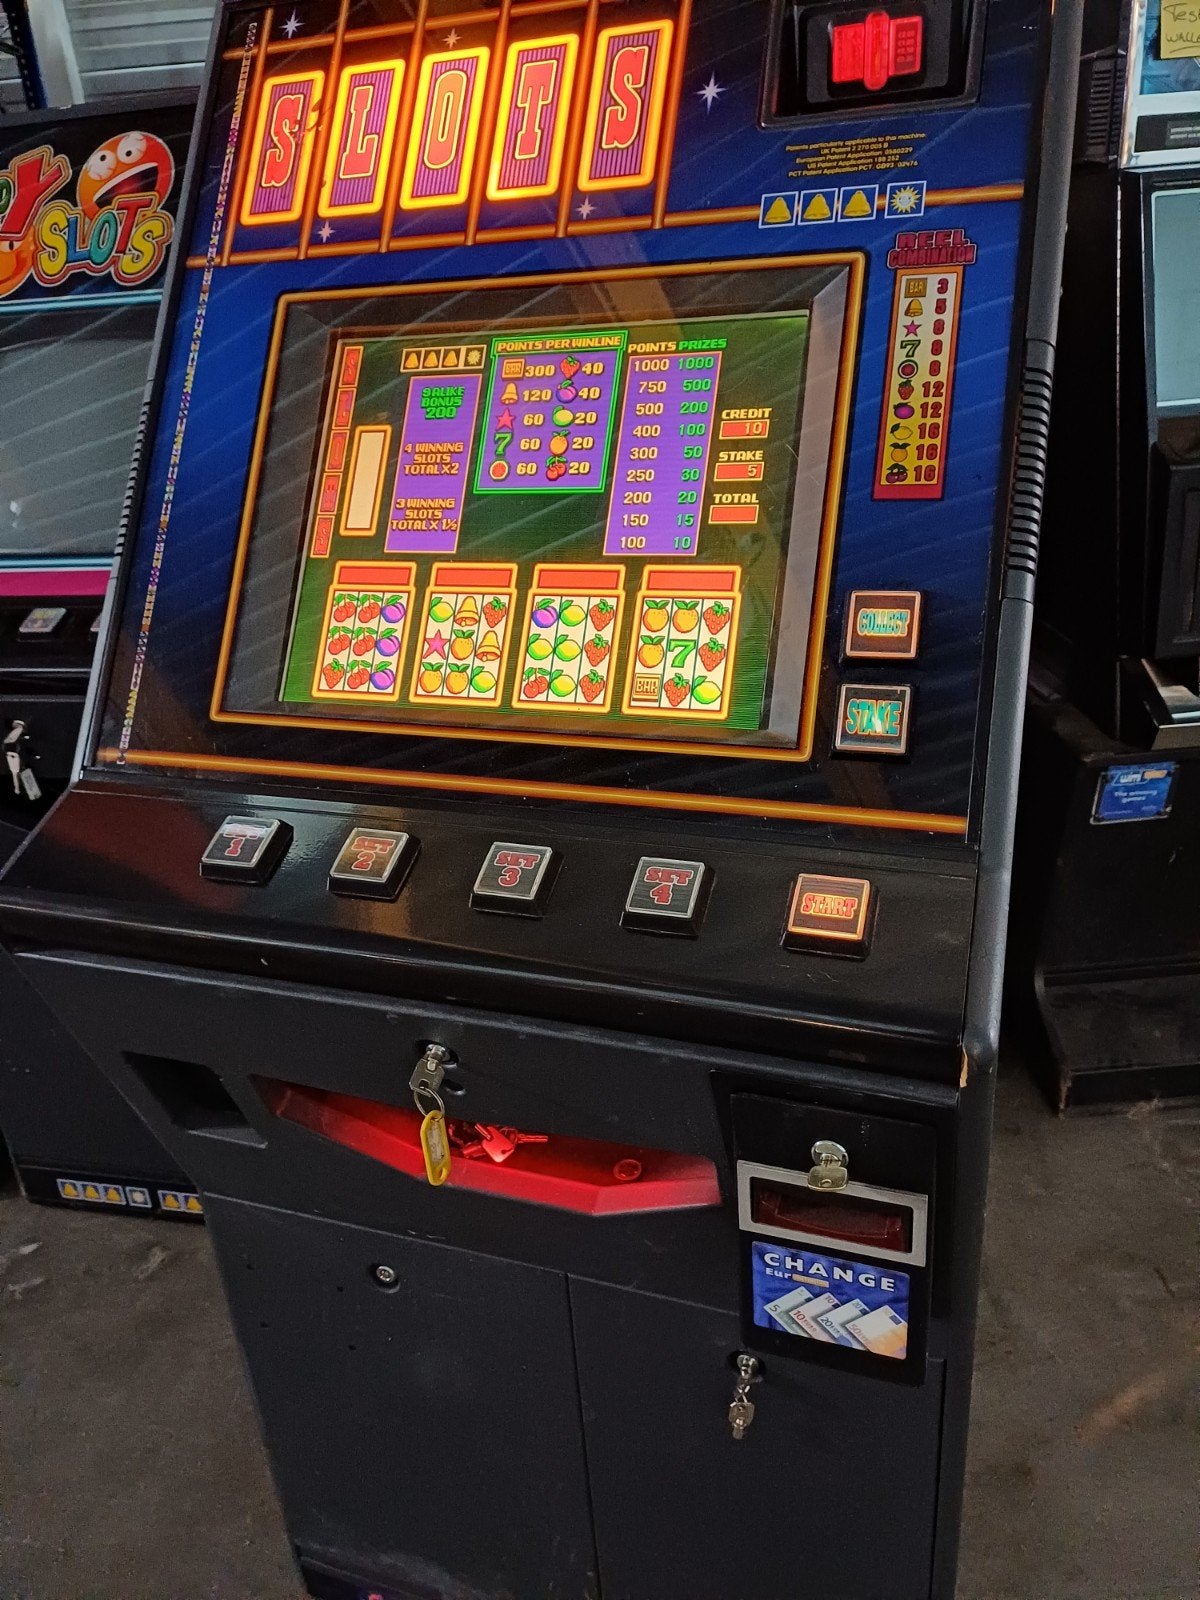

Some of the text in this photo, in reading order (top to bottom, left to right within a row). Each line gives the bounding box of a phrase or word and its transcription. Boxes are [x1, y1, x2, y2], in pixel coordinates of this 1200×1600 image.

[261, 45, 650, 188] SLOTS
[809, 140, 844, 150] particularly
[844, 136, 877, 146] applicable
[795, 155, 826, 164] European
[826, 153, 847, 161] Patent
[817, 160, 837, 168] Patent
[838, 158, 873, 167] Application
[802, 168, 823, 176] Patent
[823, 165, 858, 175] Application
[36, 196, 169, 279] SLOTS
[896, 229, 970, 249] REEL
[888, 245, 976, 268] COMBINATION
[936, 277, 949, 295] 3
[934, 297, 947, 315] 5
[932, 318, 945, 335] 8
[497, 336, 622, 352] POINTS PER WINLINE
[627, 338, 728, 353] POINTS PRIZES
[900, 339, 943, 358] 7 8
[524, 364, 556, 378] 300
[581, 362, 604, 375] 40
[633, 356, 715, 372] 1000 1000
[928, 360, 941, 377] 8
[431, 386, 465, 397] ALIKE
[638, 378, 712, 393] 750 500
[922, 380, 944, 398] 12
[421, 396, 463, 407] BONUS
[522, 386, 601, 402] 120 40
[425, 406, 457, 419] 200
[635, 400, 709, 416] 500 200
[721, 407, 772, 420] CREDIT
[920, 402, 942, 419] 12
[523, 411, 598, 426] 60 20
[632, 422, 706, 438] 400 100
[743, 422, 763, 435] 10
[917, 423, 940, 440] 16
[404, 442, 464, 453] 4 WINNING
[519, 438, 541, 450] 60
[571, 436, 594, 449] 20
[413, 453, 451, 464] SLOTS
[629, 445, 703, 460] 300 50
[718, 450, 764, 461] STAKE
[915, 443, 938, 460] 16
[404, 464, 440, 475] TOTAL
[516, 461, 591, 475] 60 20
[626, 468, 700, 482] 250 30
[747, 465, 757, 477] 5
[913, 465, 936, 482] 16
[395, 498, 456, 509] 3 WINNING
[623, 490, 697, 505] 200 20
[713, 493, 760, 504] TOTAL
[404, 509, 443, 519] SLOTS
[622, 513, 694, 527] 150 15
[390, 519, 428, 531] TOTAL
[620, 536, 692, 549] 100 10
[857, 608, 911, 638] COLLECT
[846, 698, 902, 737] STAKE
[225, 837, 245, 857] 1
[351, 835, 396, 854] SET
[351, 851, 376, 871] 2
[494, 850, 542, 868] SET
[498, 866, 522, 887] 3
[644, 866, 694, 885] SET
[650, 883, 673, 905] 4
[800, 892, 859, 920] START
[763, 1252, 896, 1293] CHANGE
